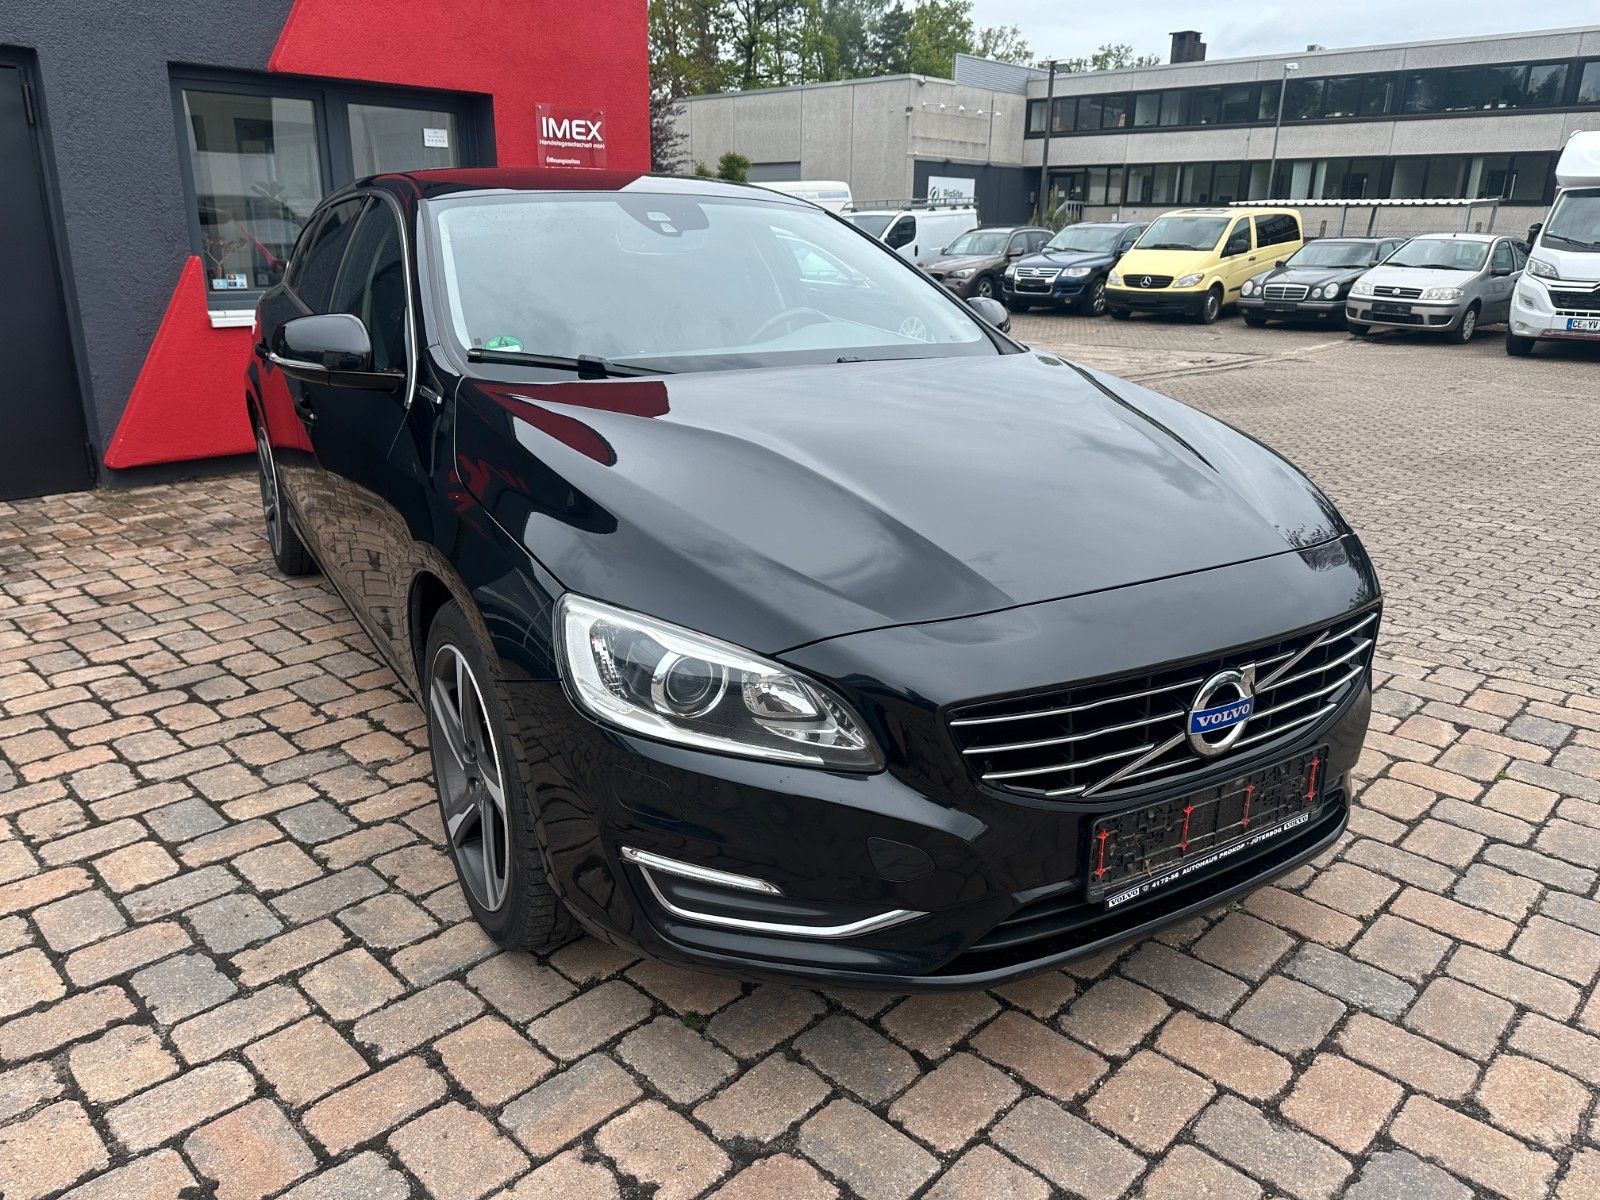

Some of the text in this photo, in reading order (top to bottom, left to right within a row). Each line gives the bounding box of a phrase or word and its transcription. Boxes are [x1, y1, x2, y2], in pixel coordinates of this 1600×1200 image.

[541, 116, 603, 141] IMEX
[539, 139, 593, 149] Handelsgesellschaft
[545, 156, 581, 166] Öffnungszeiten
[1572, 320, 1583, 328] CE
[1196, 703, 1250, 727] VOLVO
[1109, 888, 1139, 908] VOLVO
[1182, 855, 1218, 875] AUTOHAUS
[1219, 843, 1245, 859] PROKOP
[1250, 827, 1282, 845] JÜTERBOG
[1283, 814, 1309, 831] VOLVO
